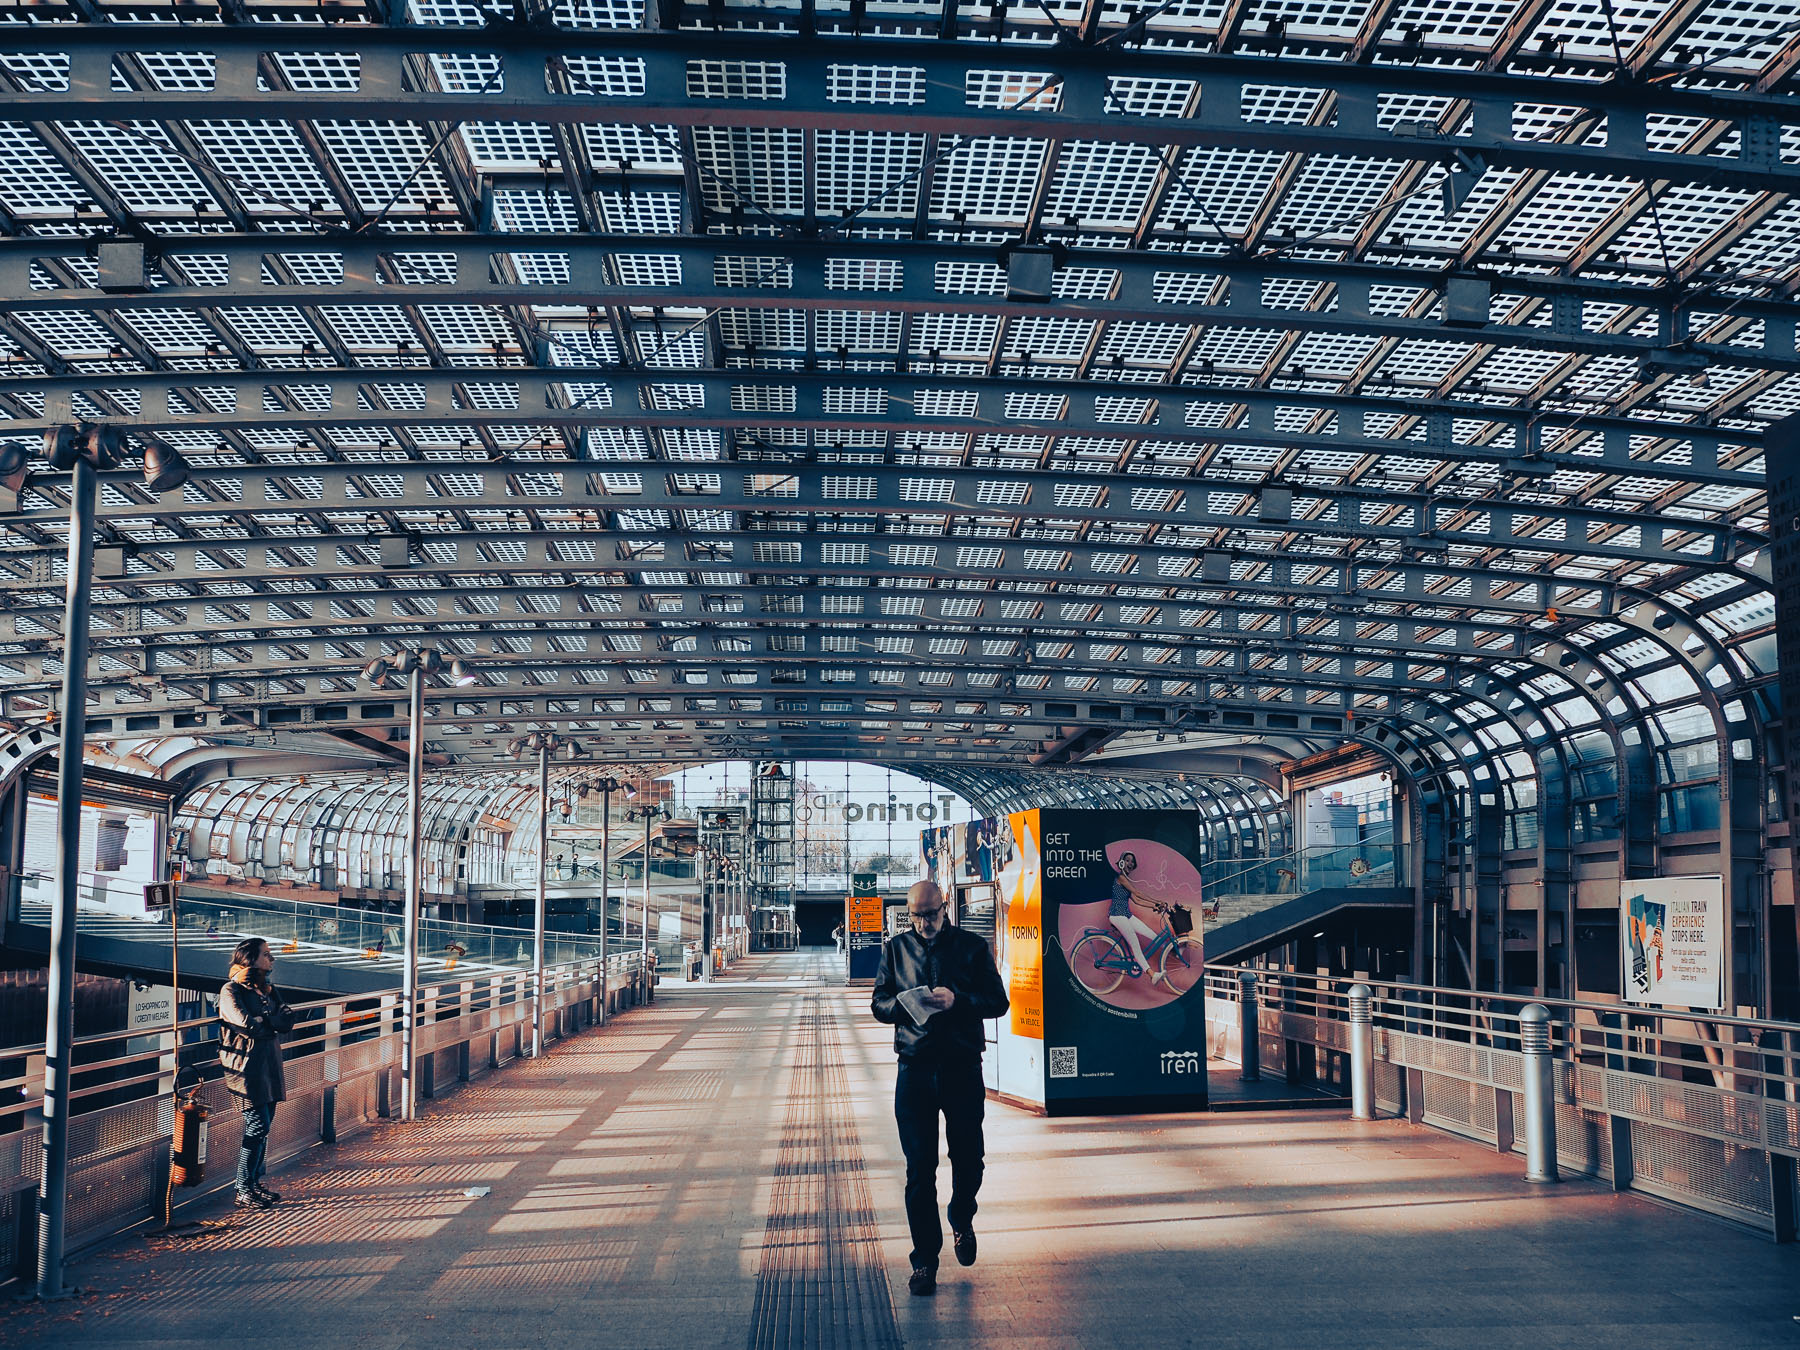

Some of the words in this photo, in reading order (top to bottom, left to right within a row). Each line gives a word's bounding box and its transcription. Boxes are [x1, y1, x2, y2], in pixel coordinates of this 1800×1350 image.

[1046, 833, 1070, 845] GET
[1046, 850, 1075, 862] INTO
[1078, 850, 1103, 862] THE
[1046, 866, 1087, 878] GREEN
[1671, 901, 1690, 913] ITALIAN
[1691, 901, 1708, 913] TRAIN
[1672, 915, 1705, 928] EXPERIENCE
[1011, 925, 1039, 940] TORINO
[1671, 930, 1689, 942] STOPS
[1689, 930, 1706, 942] HERE.
[136, 1003, 141, 1012] LO
[141, 1000, 160, 1010] SHOPPING
[160, 1000, 170, 1009] CON
[1029, 1008, 1040, 1016] PIANO
[152, 1011, 170, 1021] WELFARE
[1161, 1057, 1199, 1074] iren
